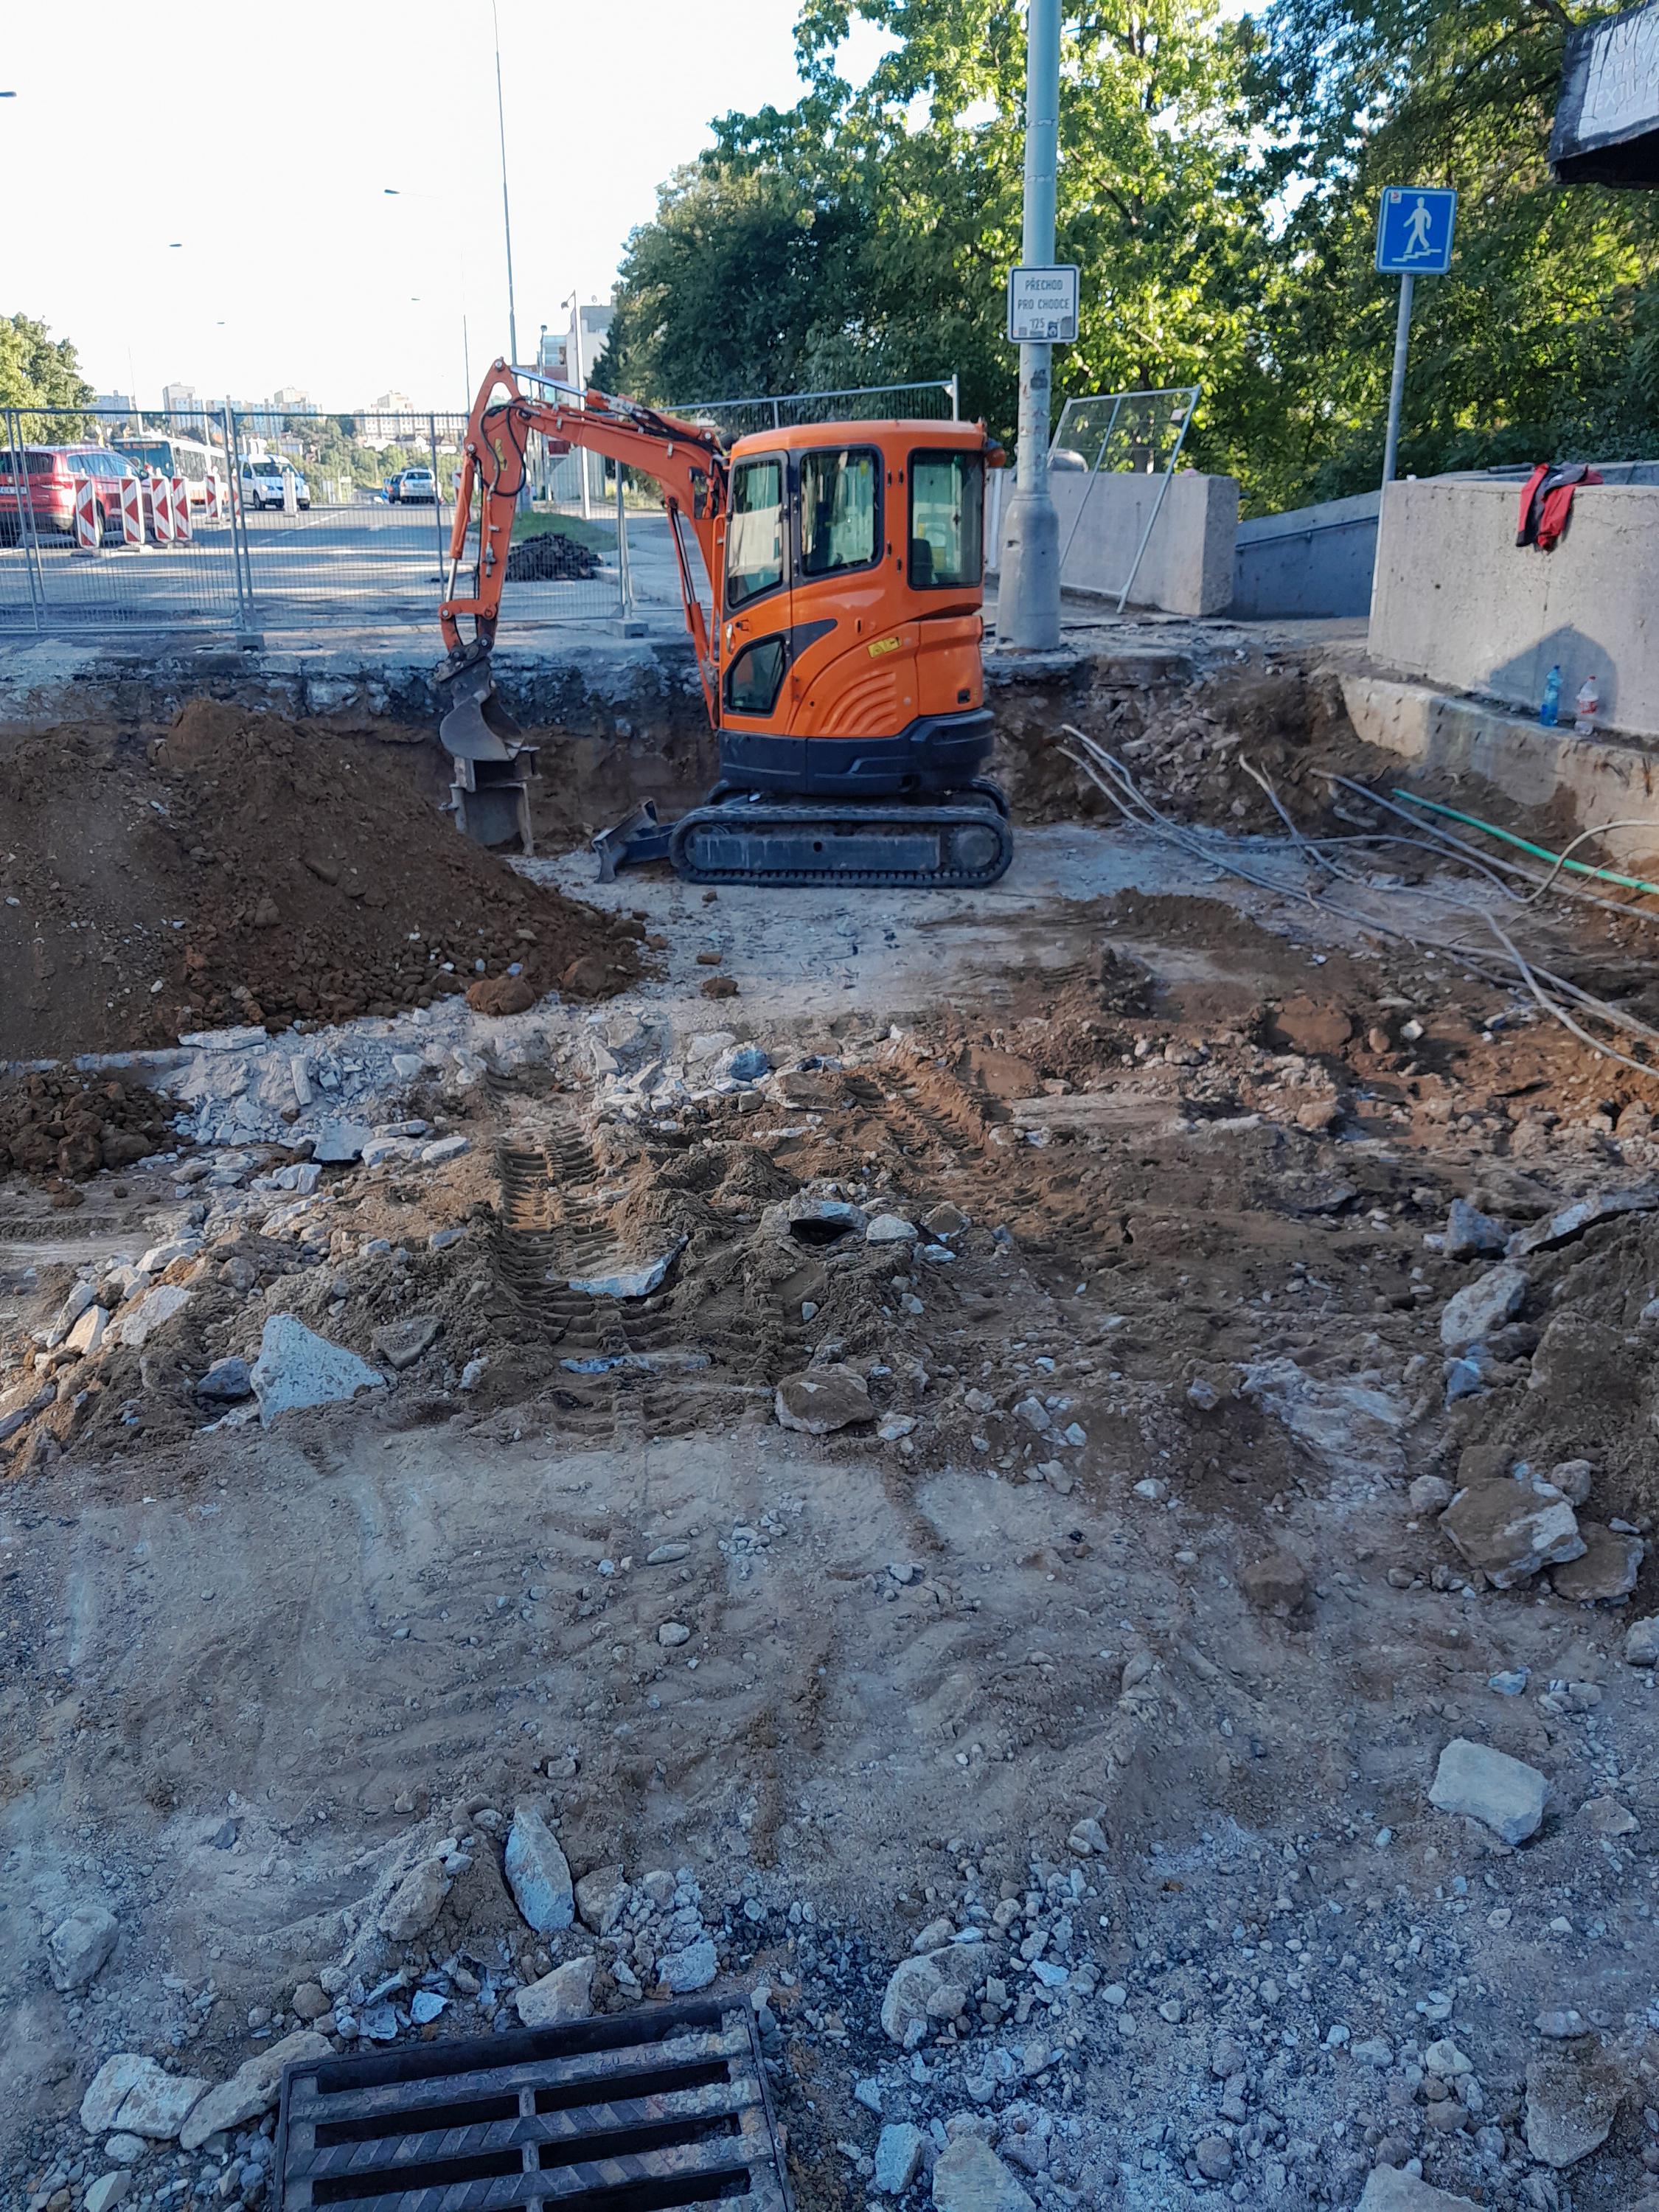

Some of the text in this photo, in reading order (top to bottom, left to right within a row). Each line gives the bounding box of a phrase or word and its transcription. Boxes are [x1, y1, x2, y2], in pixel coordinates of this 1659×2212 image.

[1025, 277, 1063, 291] PŘECHOD
[1018, 298, 1070, 310] PRO CHODCE
